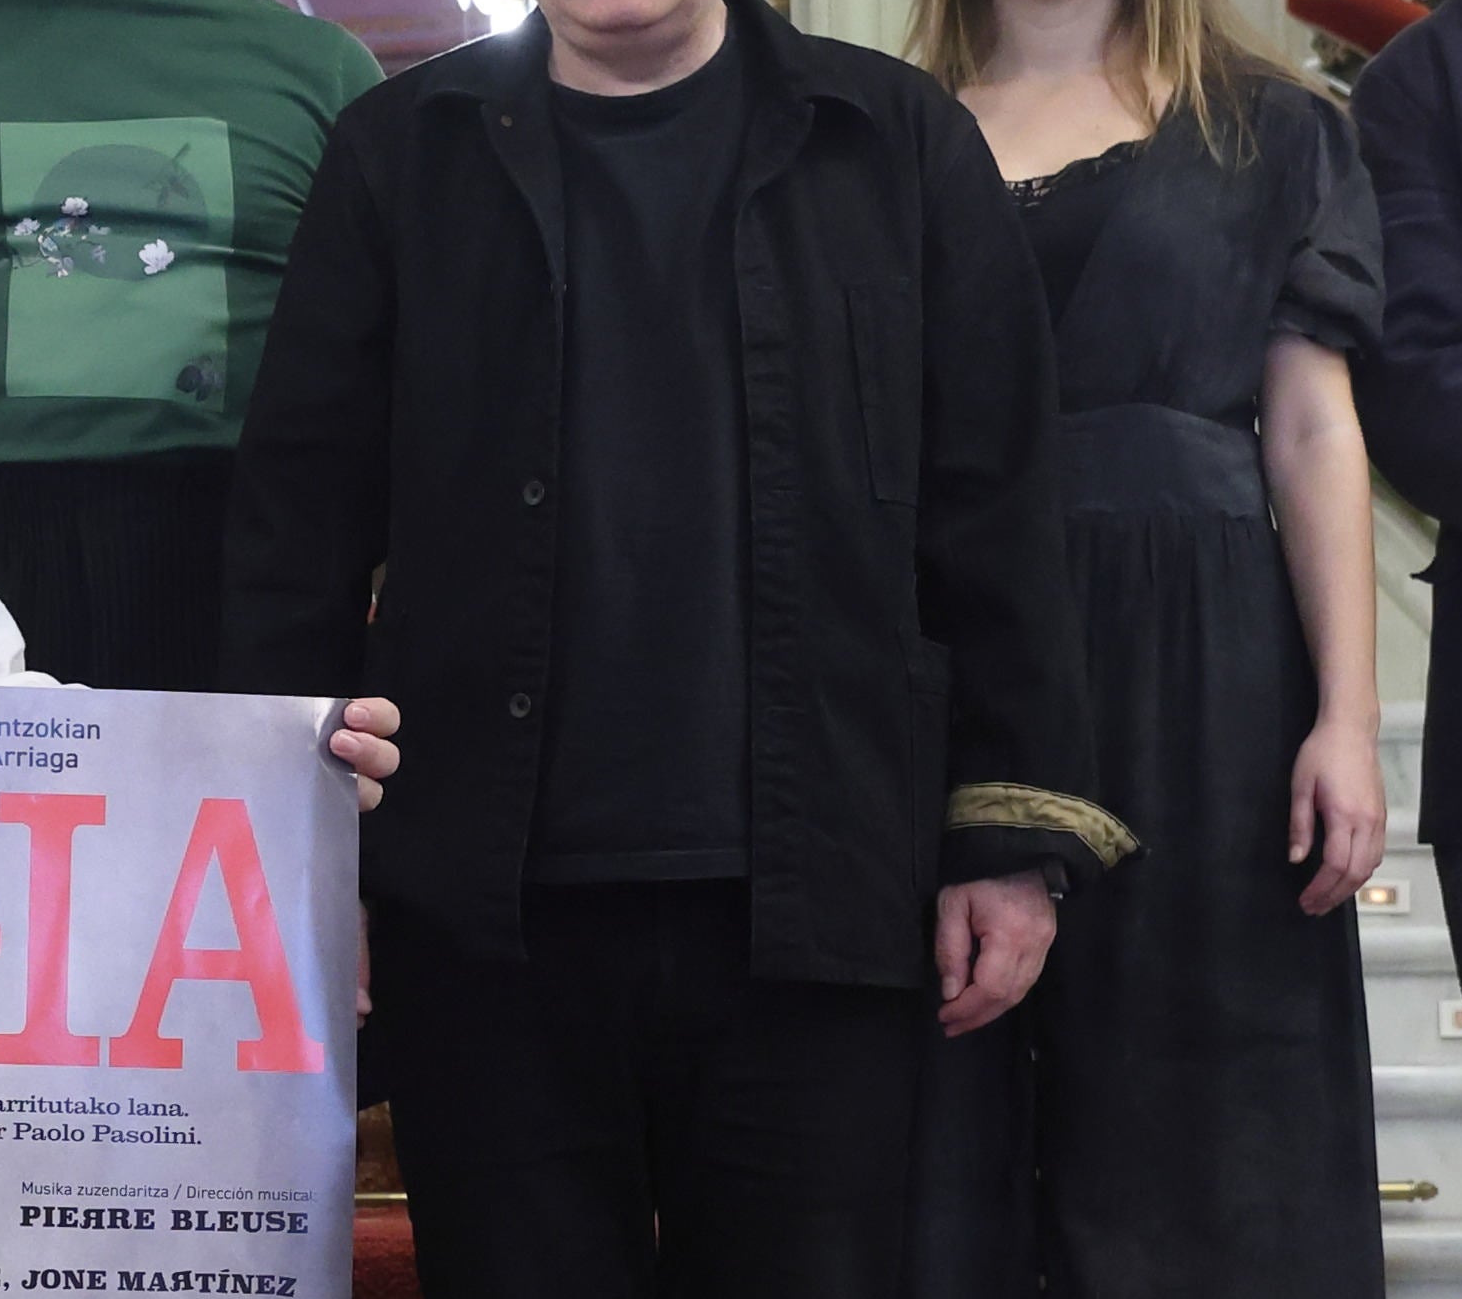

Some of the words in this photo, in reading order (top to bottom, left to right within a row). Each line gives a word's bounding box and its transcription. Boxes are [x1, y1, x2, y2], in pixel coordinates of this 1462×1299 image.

[127, 1098, 189, 1118] lana.
[13, 1122, 85, 1143] Paolo
[92, 1124, 202, 1146] Pasolini.
[21, 1182, 72, 1196] Musika
[77, 1183, 169, 1198] zuzendaritza
[186, 1185, 253, 1201] Dirección
[170, 1209, 309, 1234] BLEUSE
[21, 1269, 107, 1291] JONE
